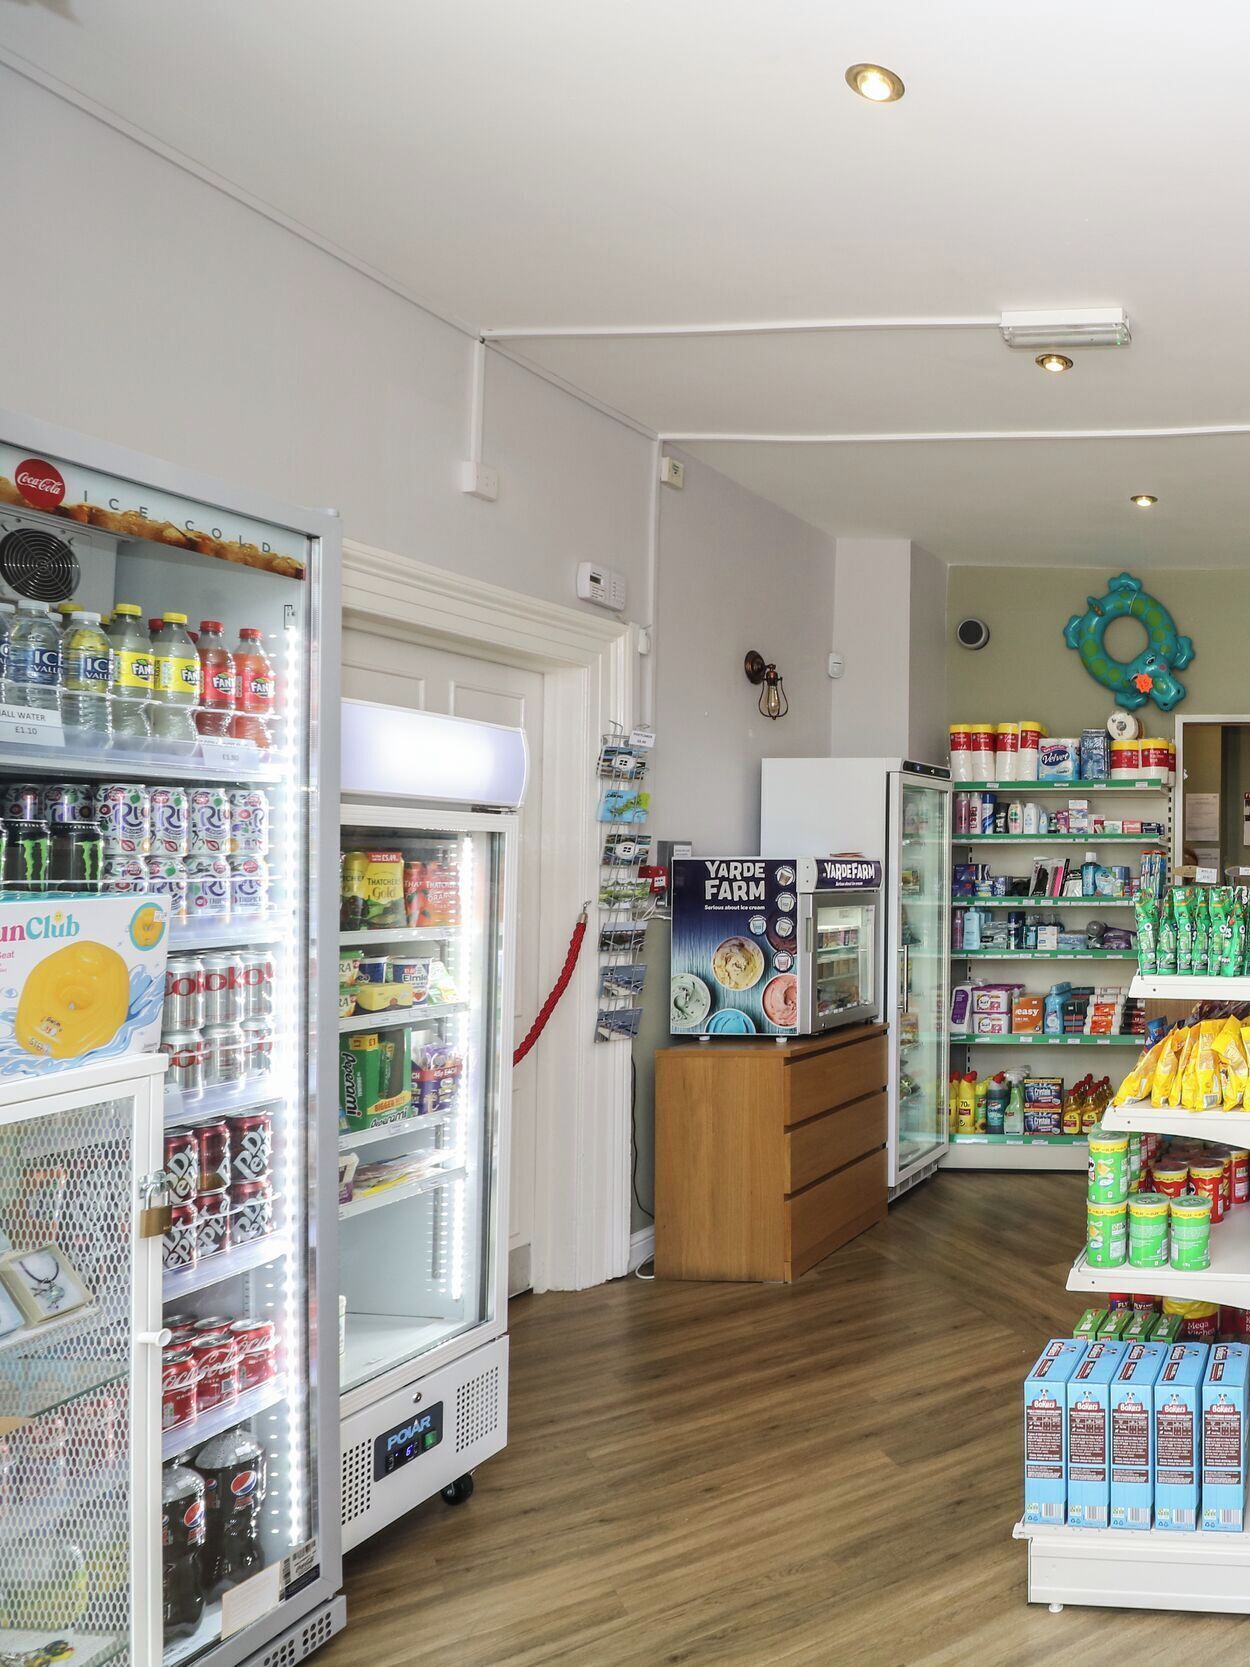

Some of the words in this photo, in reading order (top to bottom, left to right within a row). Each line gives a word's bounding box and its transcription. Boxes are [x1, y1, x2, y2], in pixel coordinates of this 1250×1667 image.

[16, 471, 62, 495] Coca-Cola
[83, 491, 148, 519] ICE
[186, 520, 271, 553] COLD
[86, 658, 111, 671] IC
[19, 712, 46, 721] WATER
[1041, 752, 1071, 765] Velvet
[705, 861, 766, 880] YARDE
[373, 887, 395, 900] Gold
[705, 880, 766, 901] FARM
[1017, 1009, 1039, 1017] easy
[342, 1052, 362, 1117] Peperami
[1188, 1321, 1208, 1330] Mega
